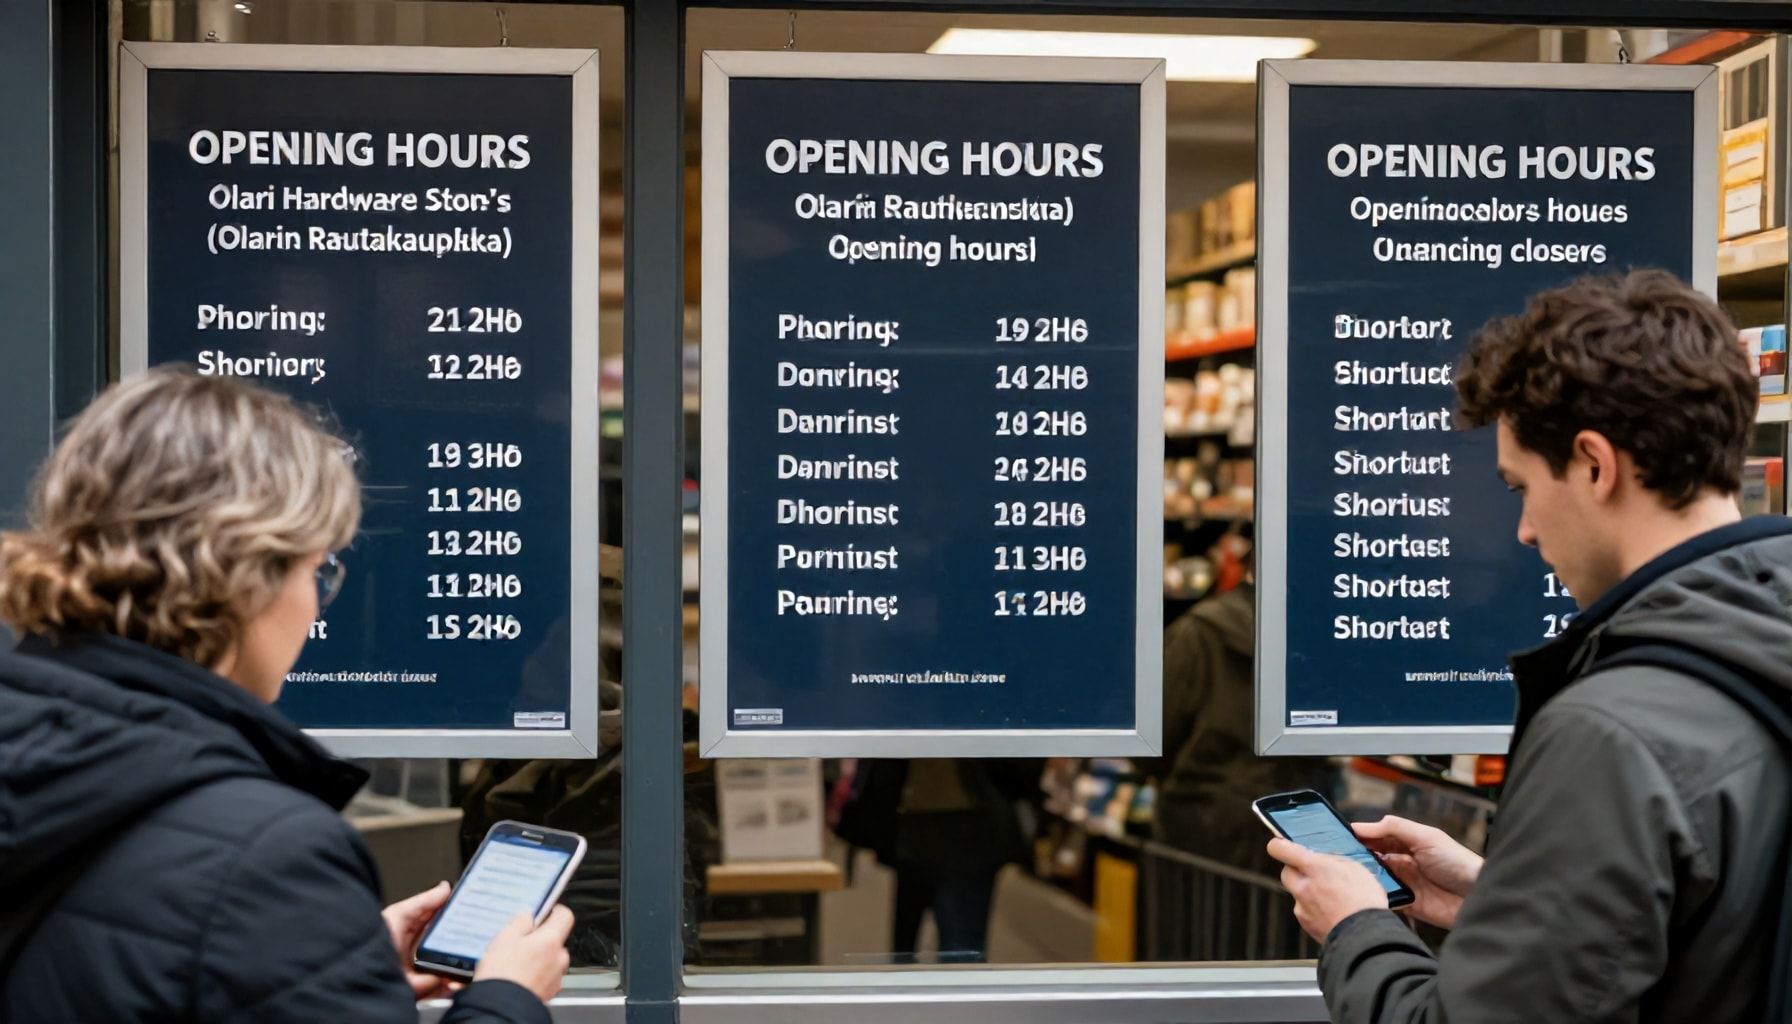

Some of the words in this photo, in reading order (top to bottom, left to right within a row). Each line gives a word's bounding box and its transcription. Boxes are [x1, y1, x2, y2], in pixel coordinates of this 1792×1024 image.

[188, 129, 374, 167] OPENING
[387, 132, 531, 170] HOURS
[765, 138, 950, 176] OPENING
[962, 141, 1104, 178] HOURS
[1327, 143, 1507, 179] OPENING
[1518, 145, 1656, 181] HOURS
[208, 183, 275, 210] Olari
[283, 185, 418, 212] Hardware
[207, 223, 301, 255] (Olarin
[828, 234, 942, 267] Opening
[427, 306, 462, 333] 21
[995, 317, 1030, 342] 19
[1034, 316, 1089, 343] 2H6
[427, 354, 463, 380] 12
[1033, 410, 1088, 437] 2H6
[427, 442, 461, 468] 19
[1032, 456, 1087, 482] 2H6
[427, 487, 462, 512] 11
